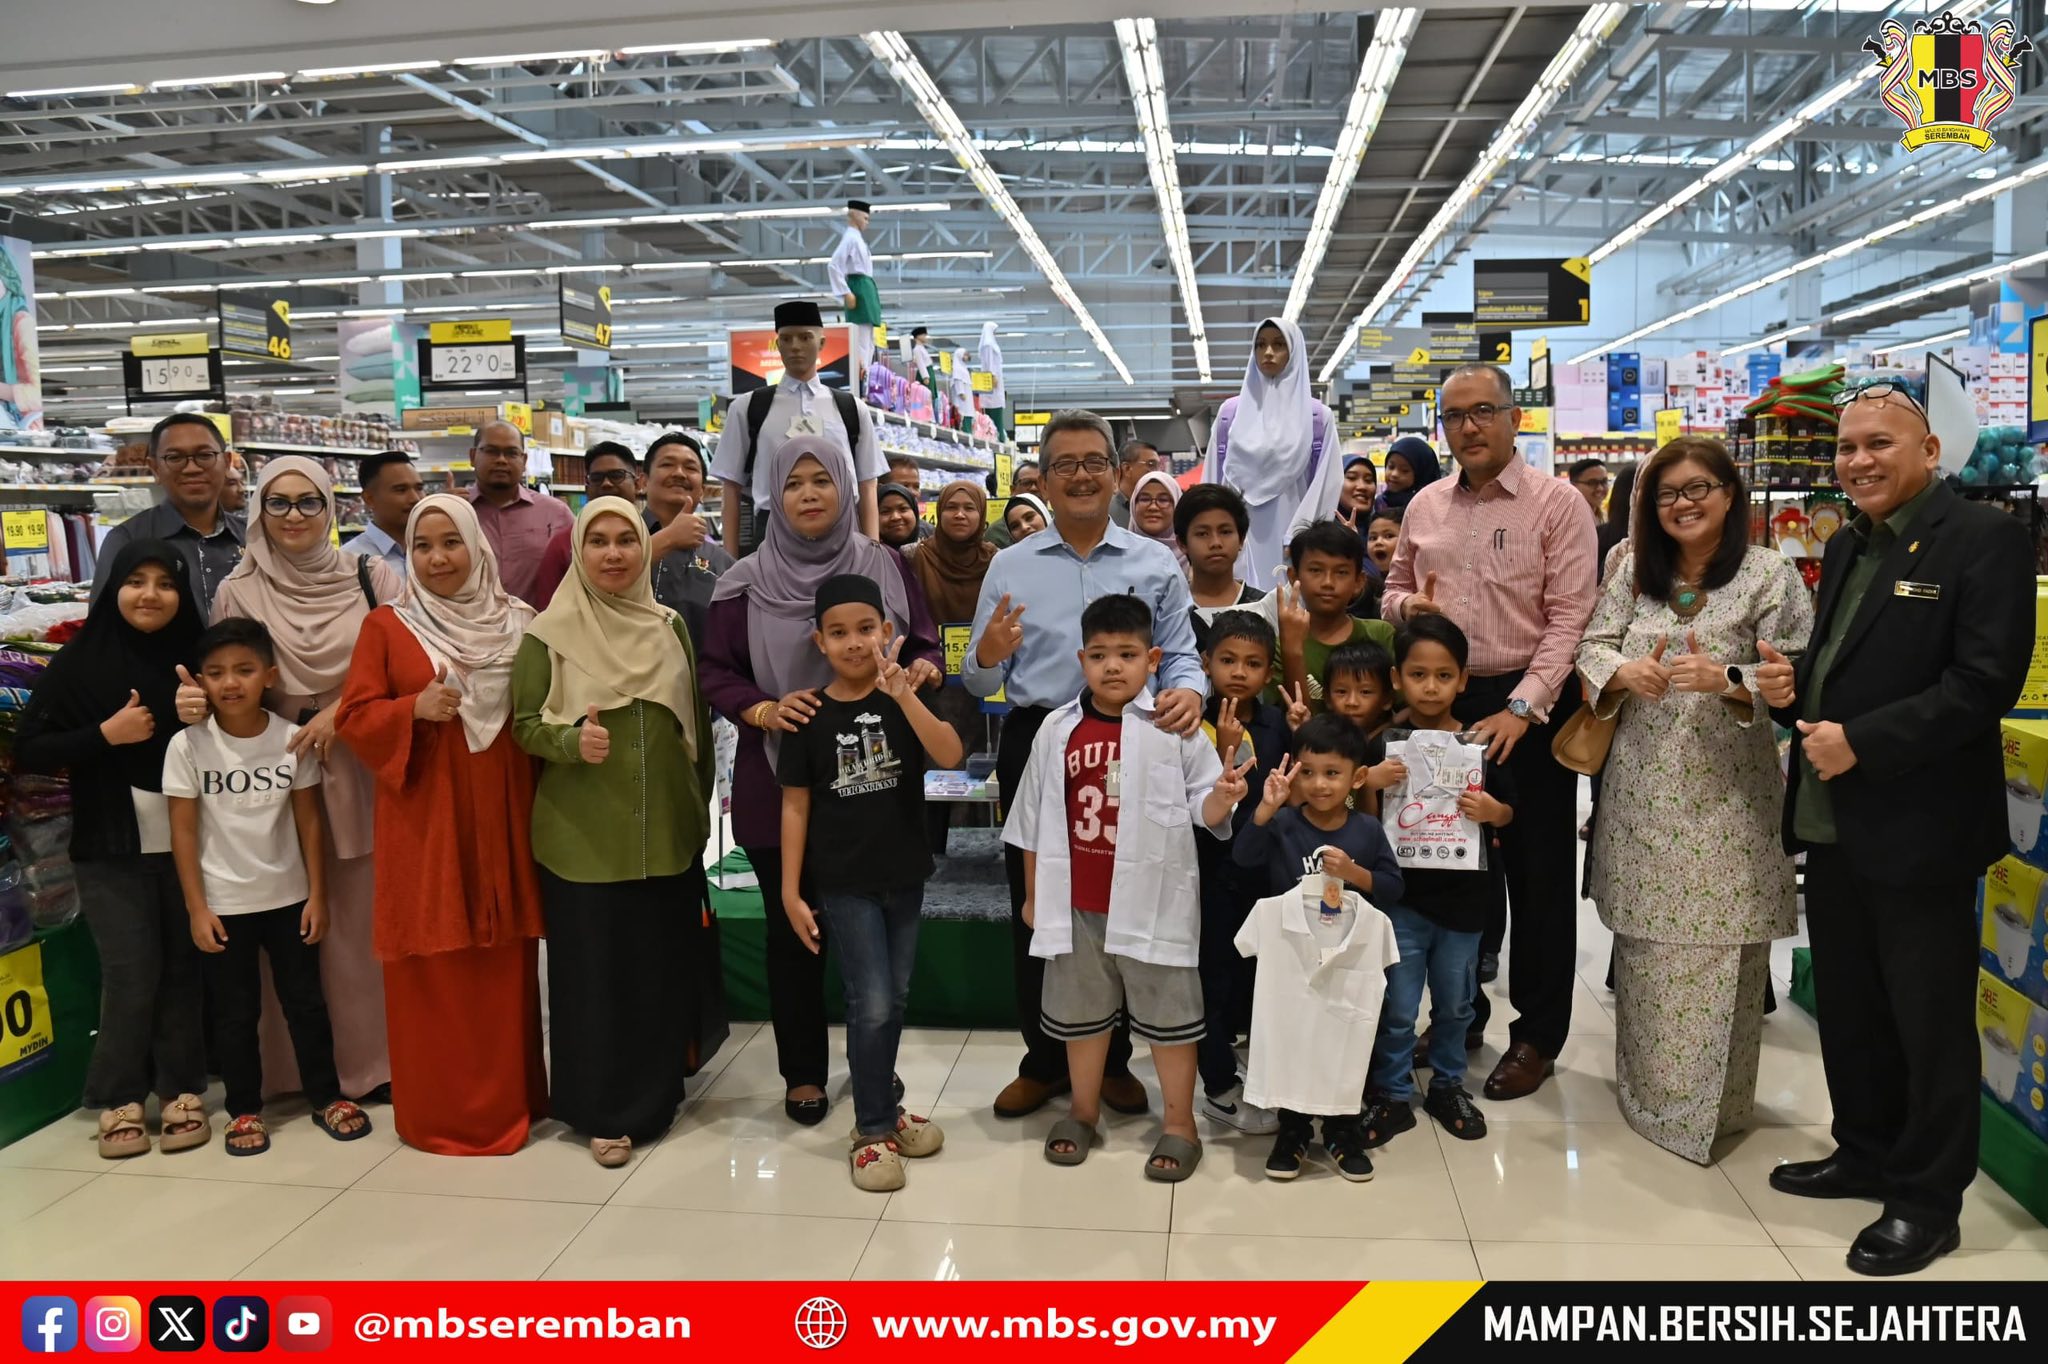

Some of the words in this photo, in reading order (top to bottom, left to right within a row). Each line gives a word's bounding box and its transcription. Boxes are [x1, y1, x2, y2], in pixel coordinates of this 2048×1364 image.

[1578, 298, 1589, 322] 1
[595, 322, 611, 346] 47
[268, 335, 291, 359] 46
[1495, 342, 1511, 362] 2
[1423, 387, 1436, 401] 4
[201, 764, 294, 795] BOSS
[19, 1036, 49, 1057] MYDIN
